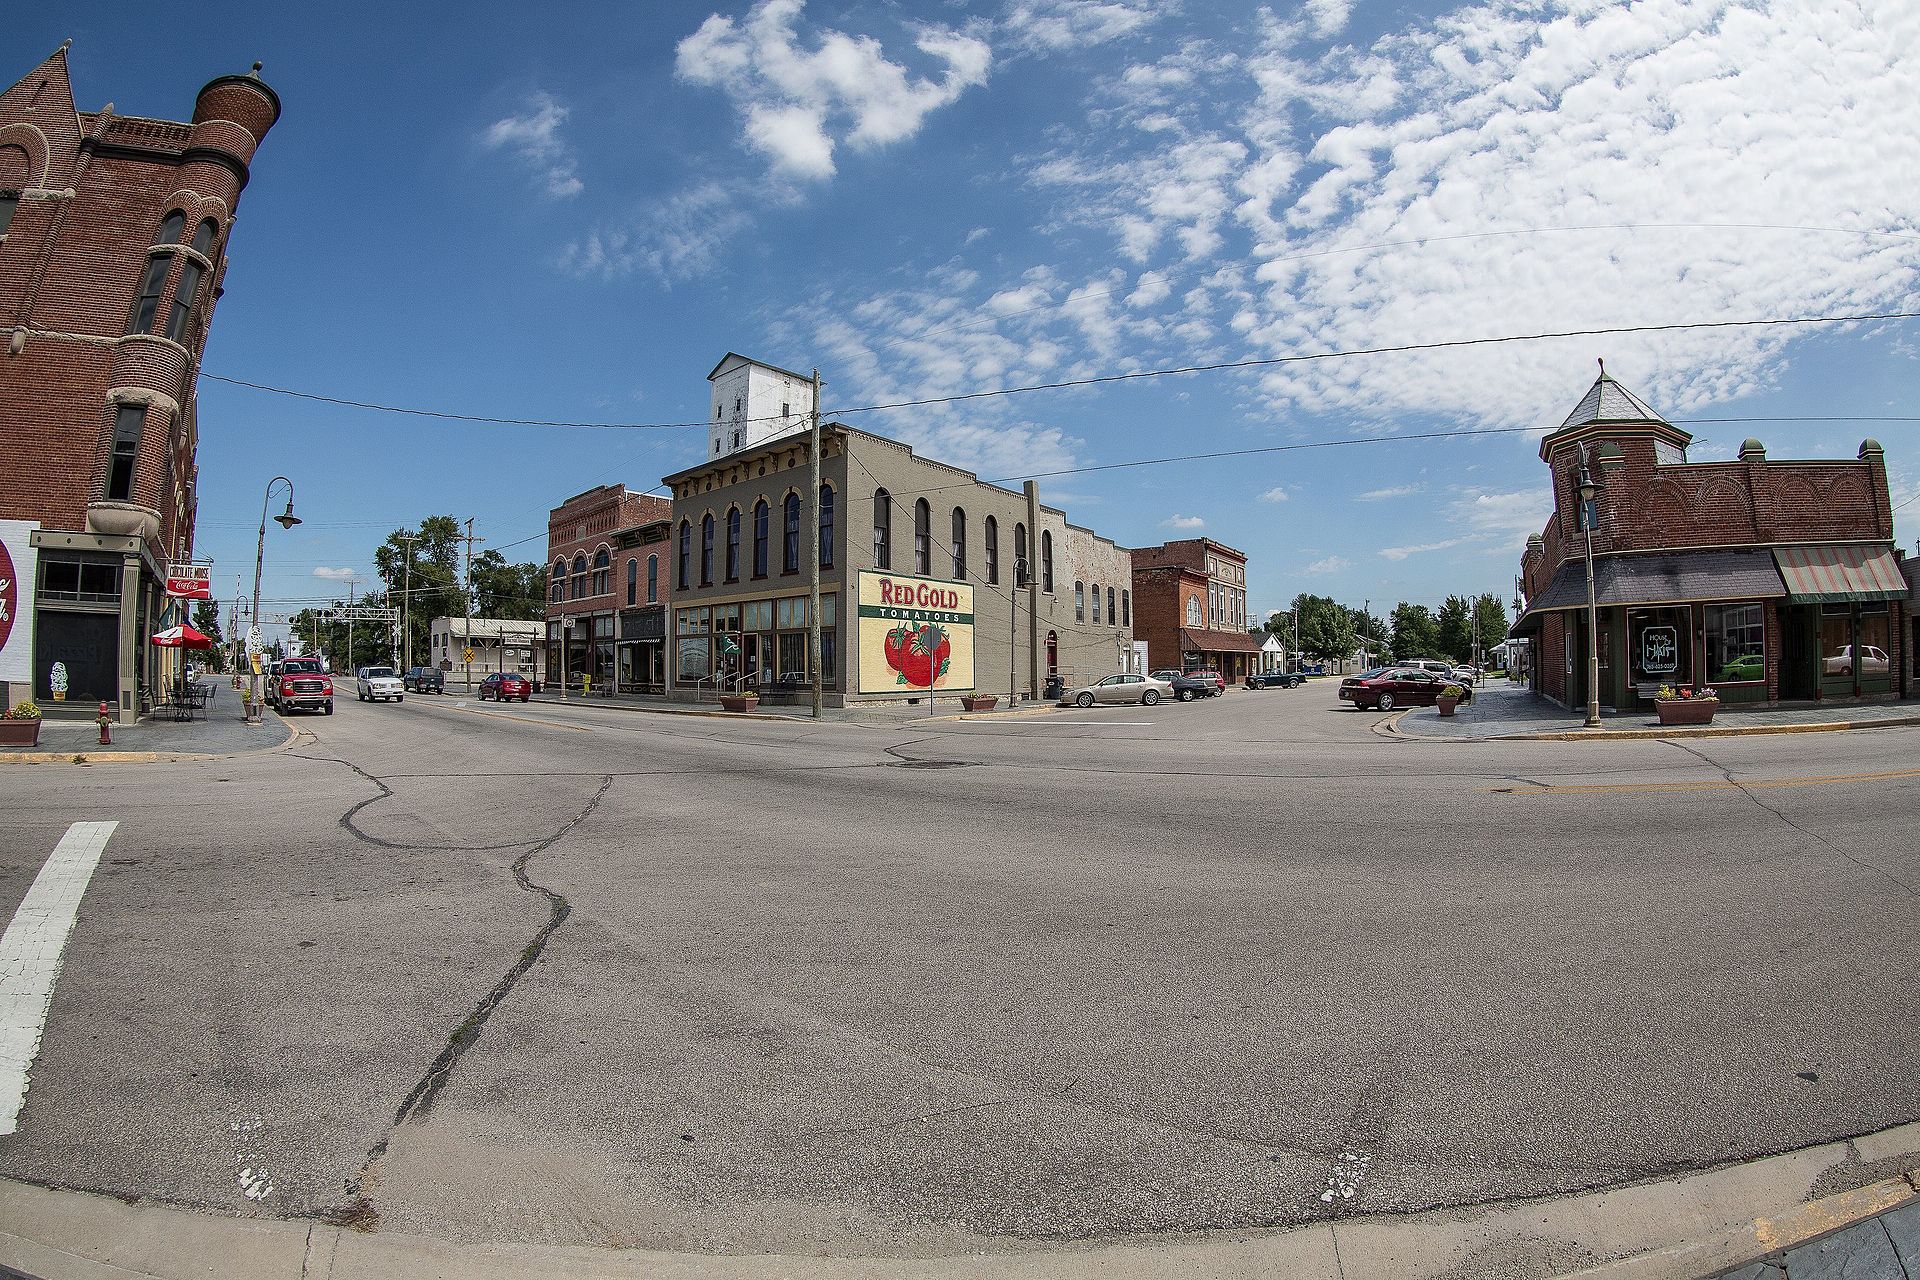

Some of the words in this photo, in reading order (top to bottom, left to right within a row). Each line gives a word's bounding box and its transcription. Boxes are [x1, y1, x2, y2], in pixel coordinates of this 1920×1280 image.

[170, 566, 193, 578] CHOCOLATE
[879, 577, 914, 606] RED
[916, 583, 958, 609] GOLD
[880, 609, 959, 622] TOMATOES
